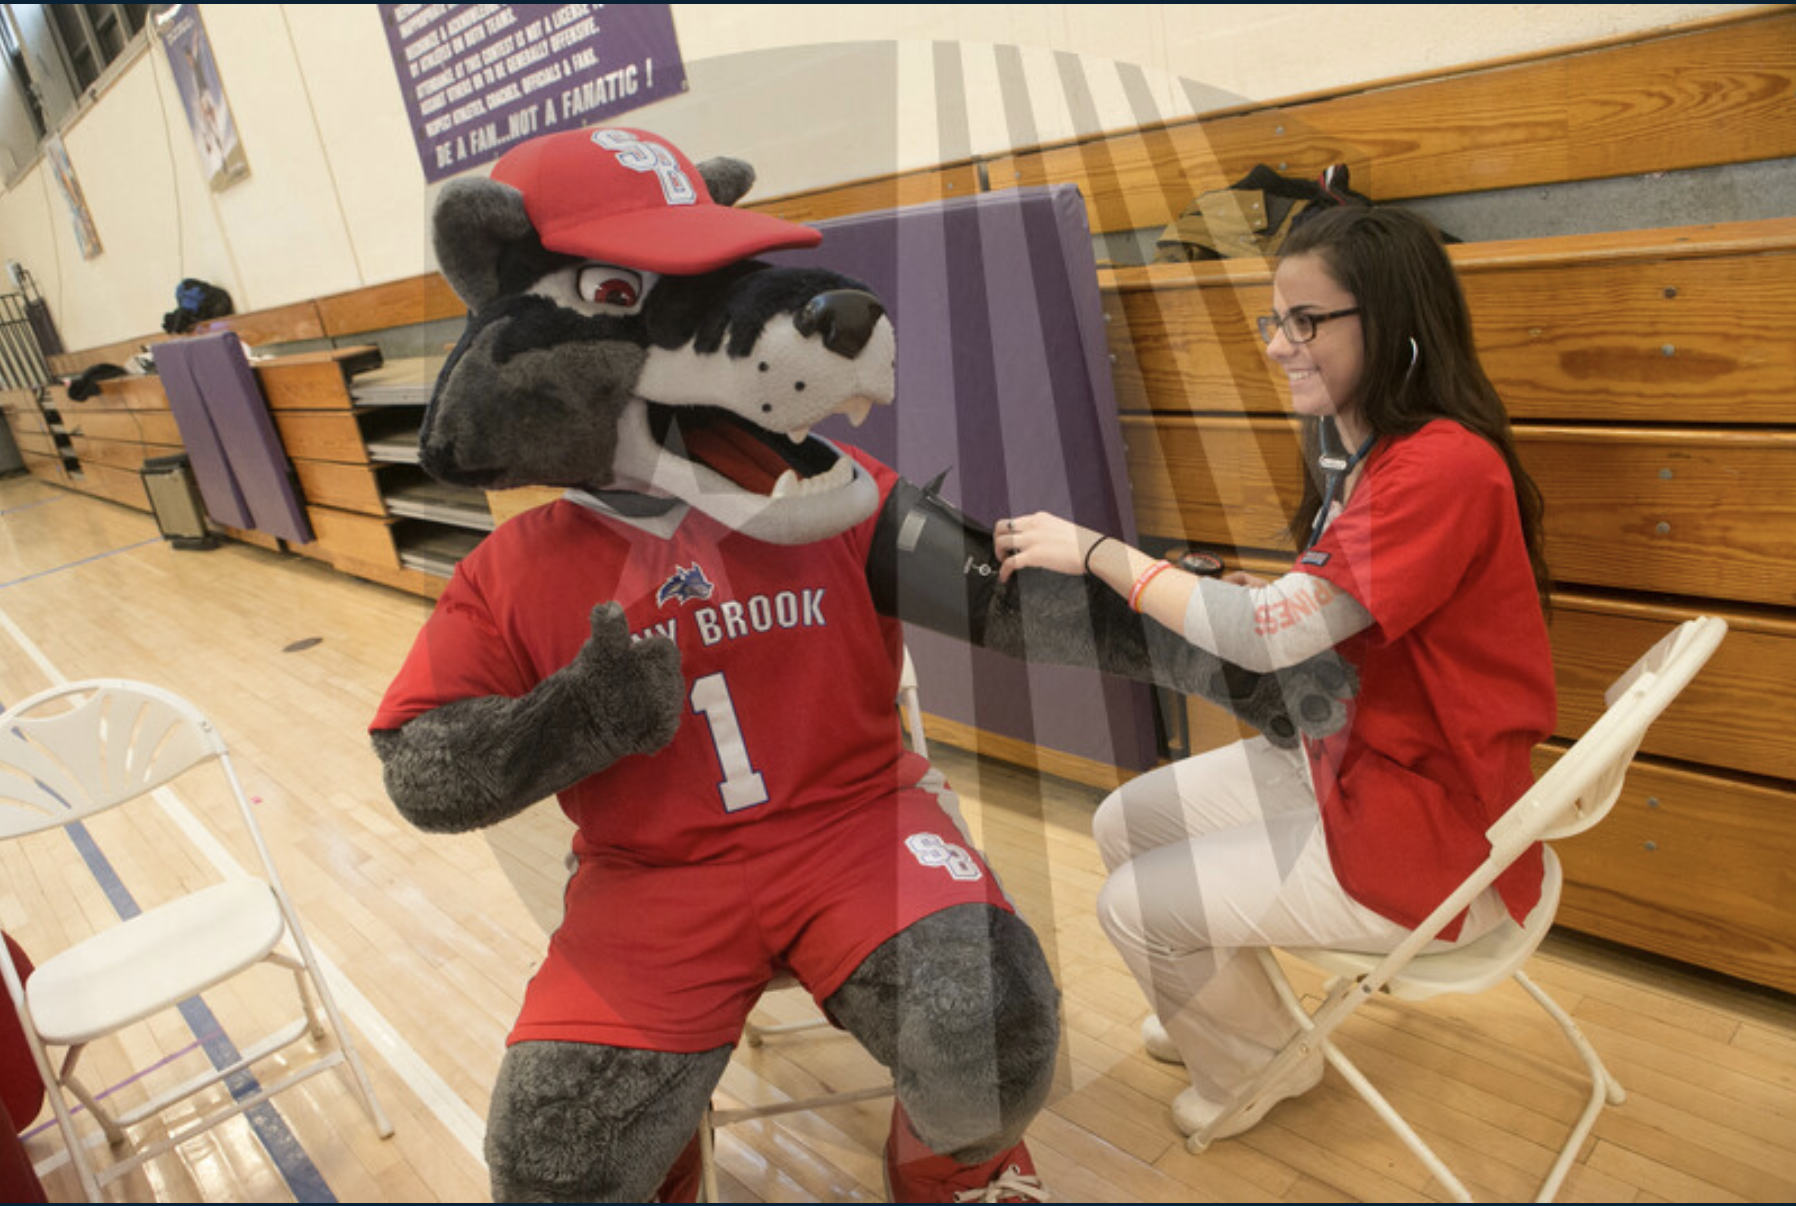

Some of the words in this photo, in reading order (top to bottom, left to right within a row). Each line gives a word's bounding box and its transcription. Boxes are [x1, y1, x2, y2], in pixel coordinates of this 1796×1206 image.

[482, 35, 514, 65] CONTEST
[515, 30, 526, 48] IS
[525, 21, 543, 42] NOT
[544, 17, 552, 33] A
[483, 67, 495, 83] TO
[494, 62, 506, 79] BE
[506, 40, 548, 74] GENERALLY
[521, 63, 562, 94] OFFICIALS
[435, 142, 453, 168] BE
[457, 137, 467, 159] A
[545, 99, 556, 125] A
[562, 64, 638, 119] FANATIC
[591, 129, 697, 206] SB
[695, 588, 827, 647] BROOK
[689, 671, 770, 814] 1
